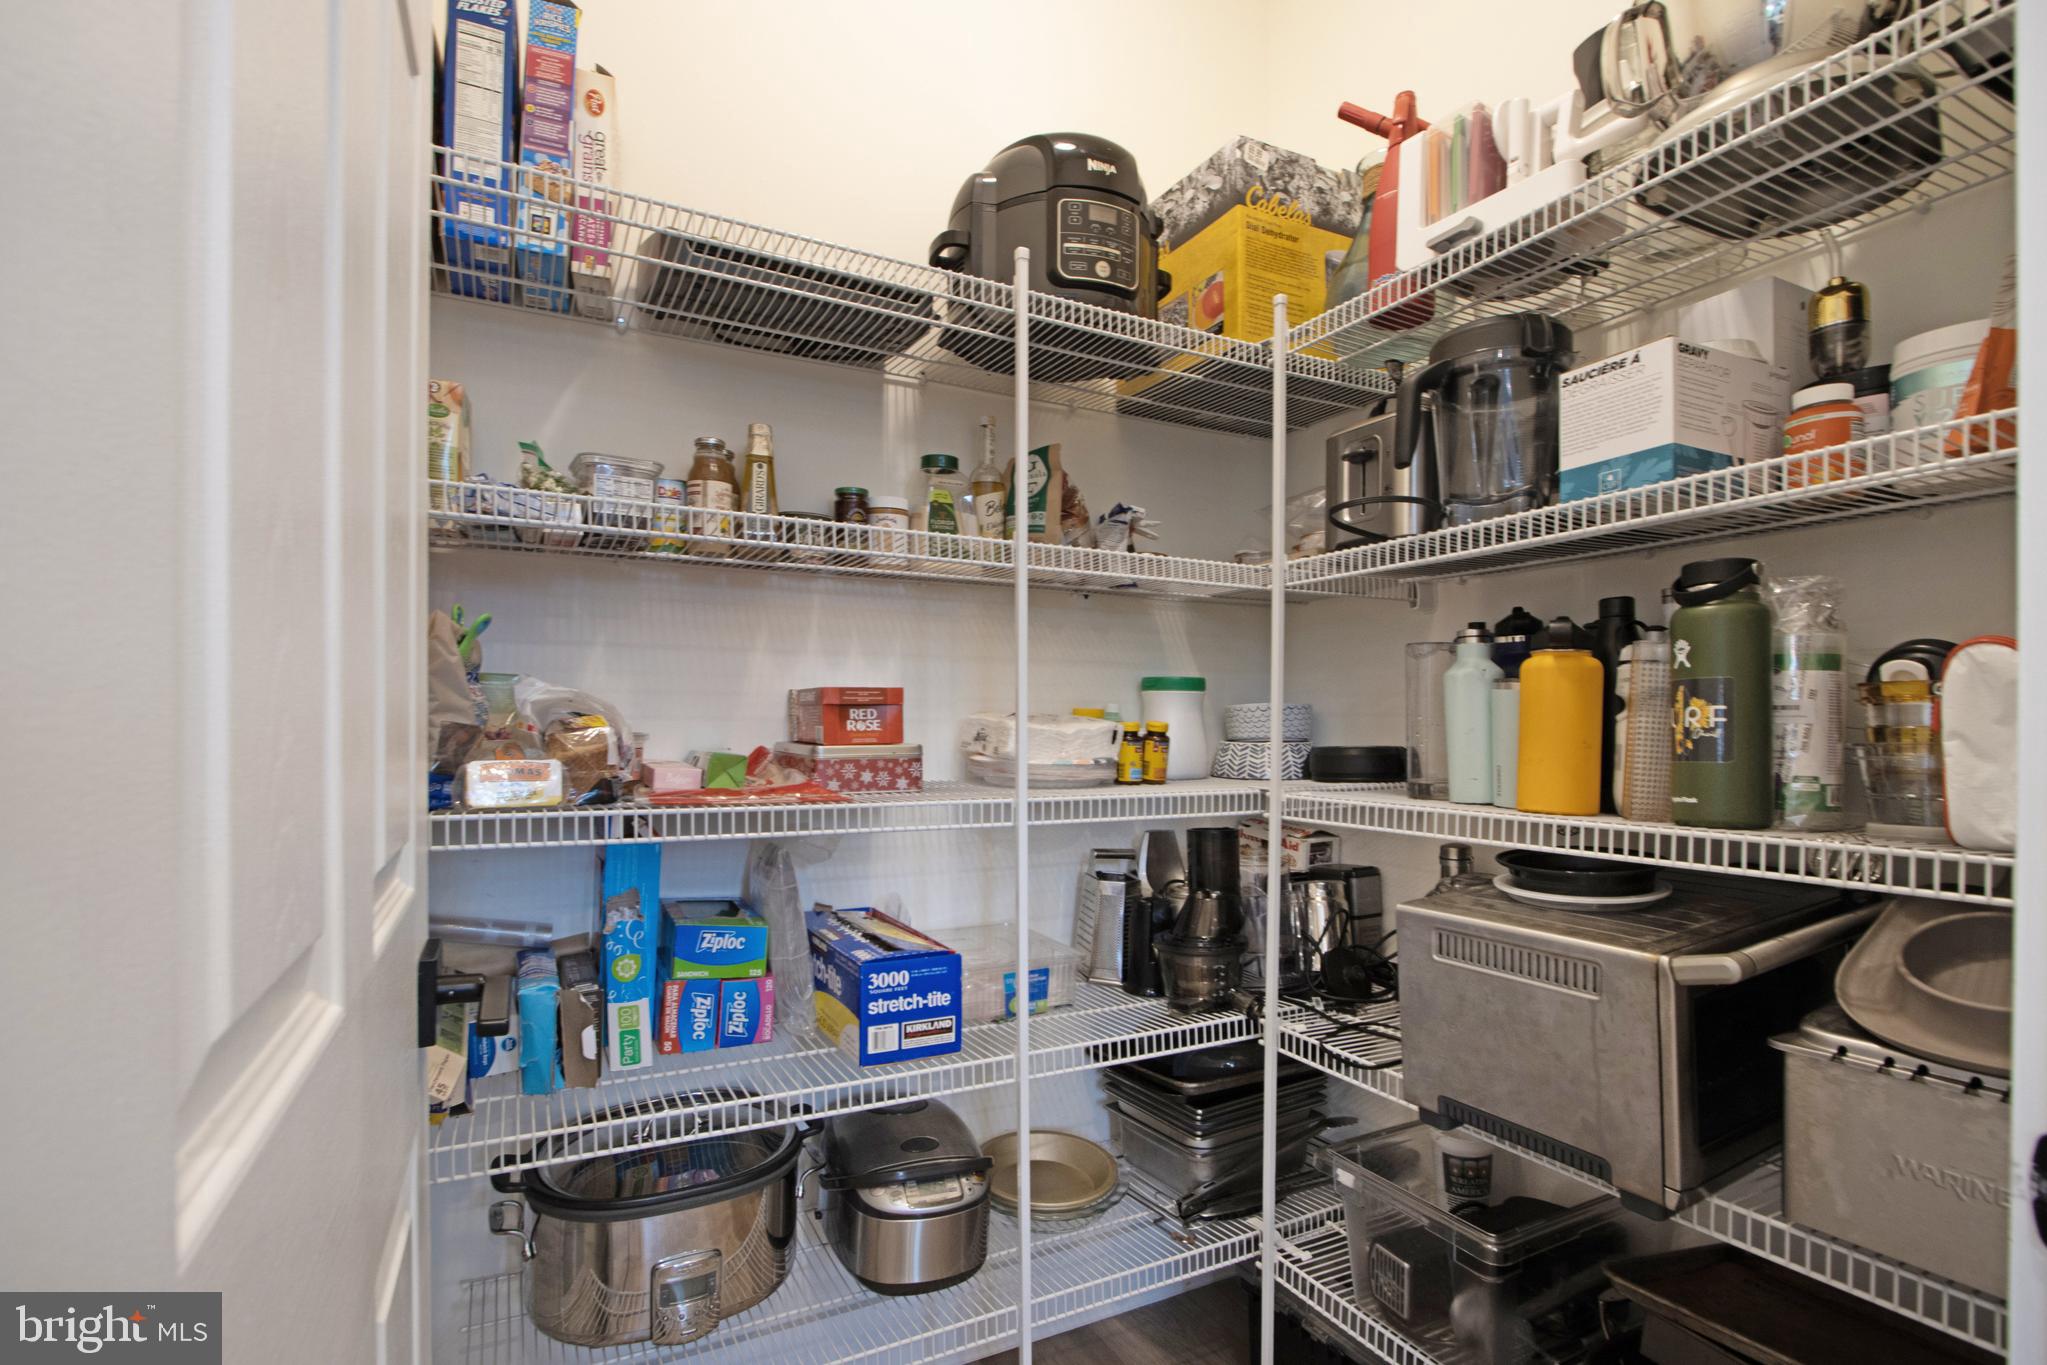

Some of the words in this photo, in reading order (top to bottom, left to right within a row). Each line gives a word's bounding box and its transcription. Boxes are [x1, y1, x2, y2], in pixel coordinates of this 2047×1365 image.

[578, 130, 593, 182] grains
[594, 131, 607, 172] great
[1678, 342, 1710, 361] GRAVY
[849, 708, 879, 721] RED
[846, 720, 882, 733] ROSE
[701, 932, 746, 954] Ziploc
[867, 970, 910, 990] 3000
[728, 991, 750, 1035] Ziploc
[867, 990, 952, 1016] stretch-tite
[621, 1007, 633, 1028] 100
[690, 996, 712, 1041] Ziploc
[905, 1019, 953, 1034] KIRKLAND
[622, 1034, 637, 1065] Party
